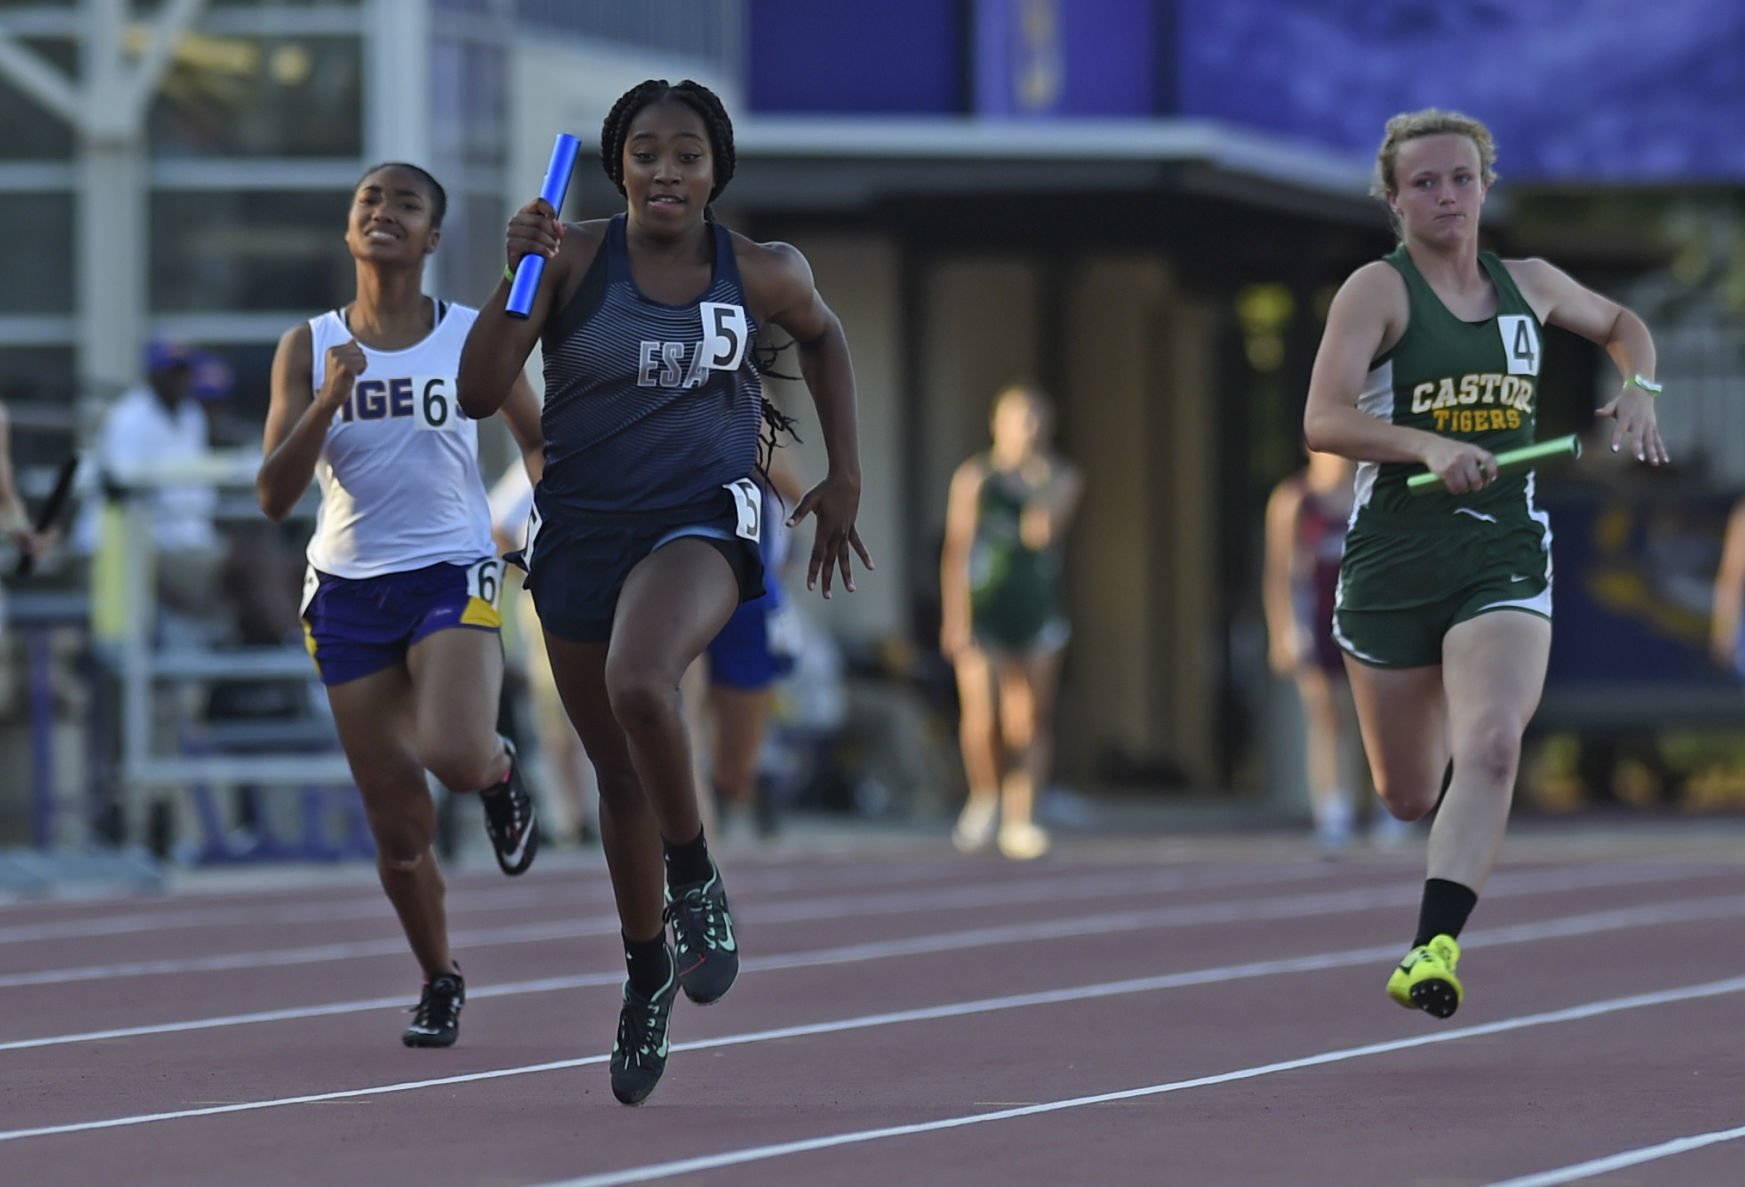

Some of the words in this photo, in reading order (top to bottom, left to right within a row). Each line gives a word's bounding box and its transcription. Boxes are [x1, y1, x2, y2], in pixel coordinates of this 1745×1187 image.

[712, 307, 738, 367] 5
[1513, 319, 1535, 371] 4
[637, 341, 710, 388] ESA
[423, 378, 448, 427] 6
[1411, 373, 1532, 414] CASTOR
[1433, 409, 1521, 432] TIGERS
[738, 481, 758, 537] 5
[478, 561, 498, 601] 6
